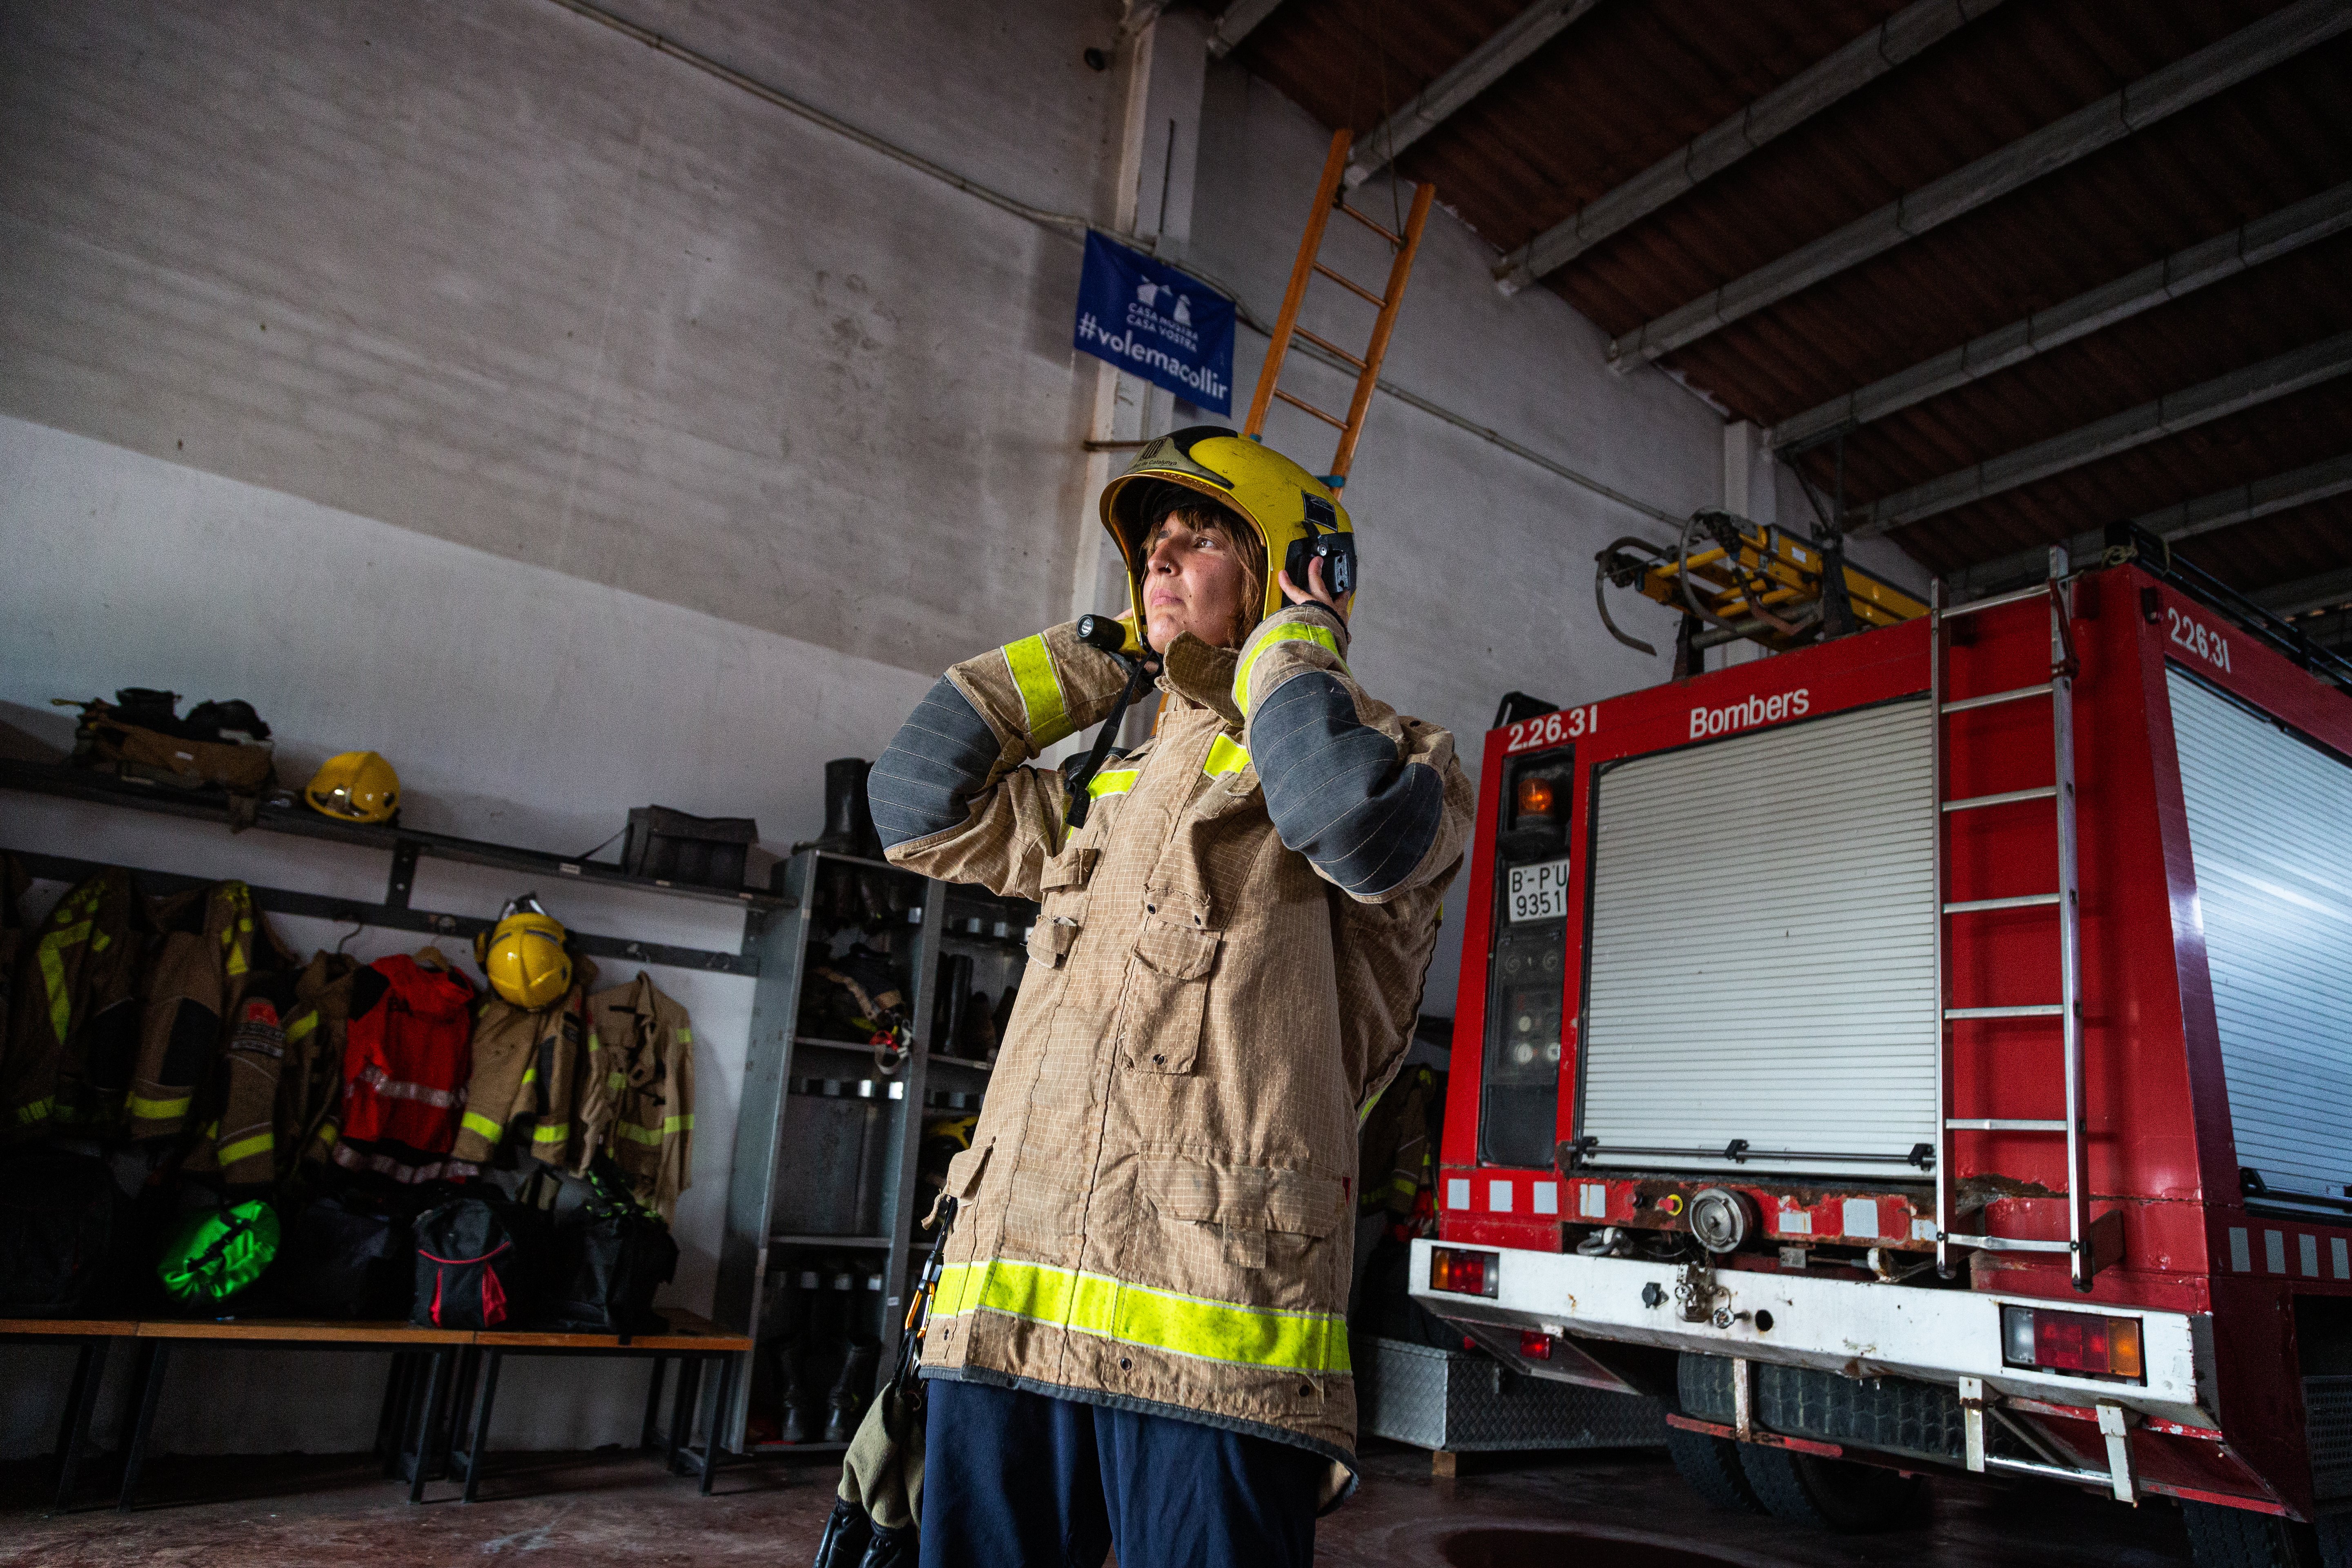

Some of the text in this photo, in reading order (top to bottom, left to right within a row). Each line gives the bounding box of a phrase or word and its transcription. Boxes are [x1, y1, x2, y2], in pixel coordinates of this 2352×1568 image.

[1126, 314, 1197, 353] CASA VOSTRA
[1128, 302, 1198, 341] CASA NOSTRA
[1078, 312, 1228, 400] #volemacollir
[1507, 704, 1597, 752] 2.26.31
[1690, 688, 1810, 739] Bombers
[1517, 890, 1561, 917] 9351
